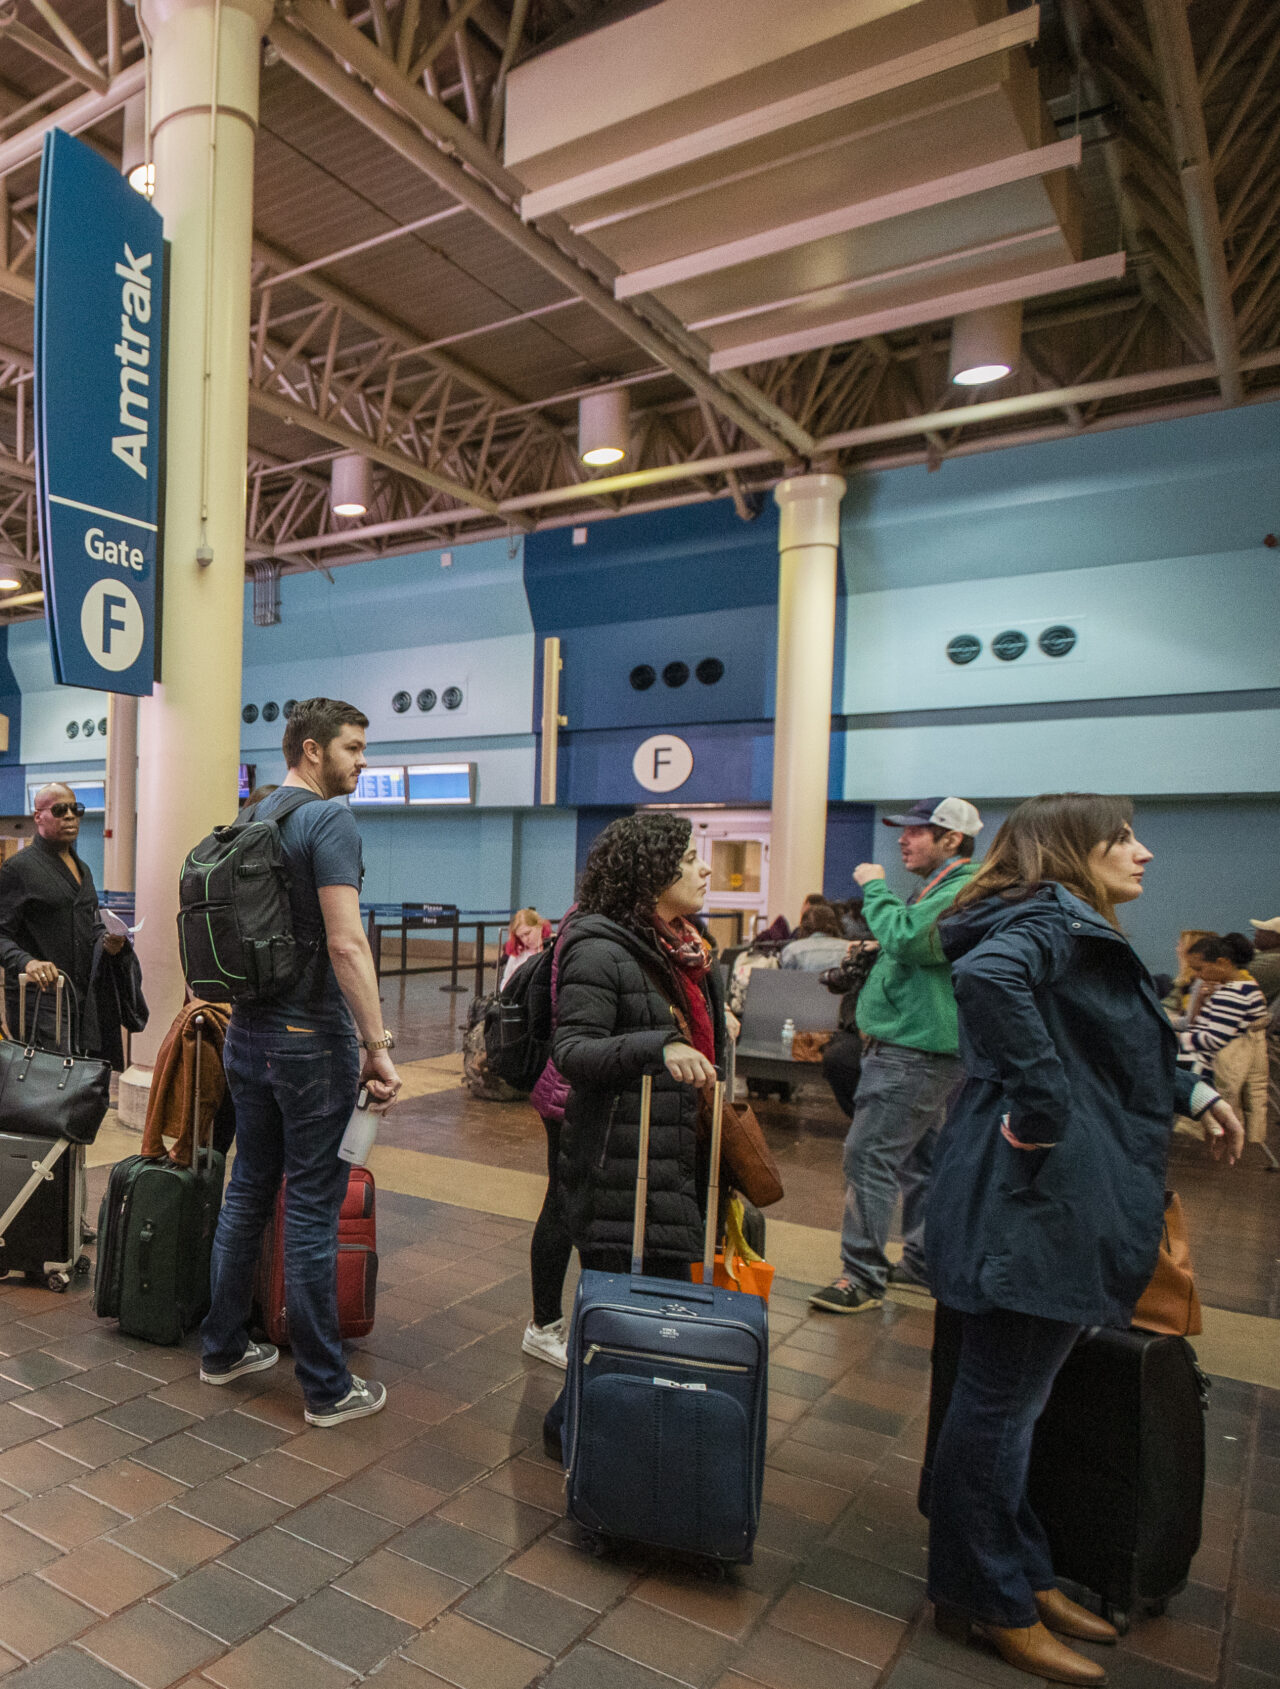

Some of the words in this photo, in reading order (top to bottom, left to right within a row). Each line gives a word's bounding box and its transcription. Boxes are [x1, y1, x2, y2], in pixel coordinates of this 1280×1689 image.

[111, 242, 153, 480] Amtrak
[84, 527, 144, 571] Gate
[102, 593, 127, 655] F
[653, 747, 672, 779] F
